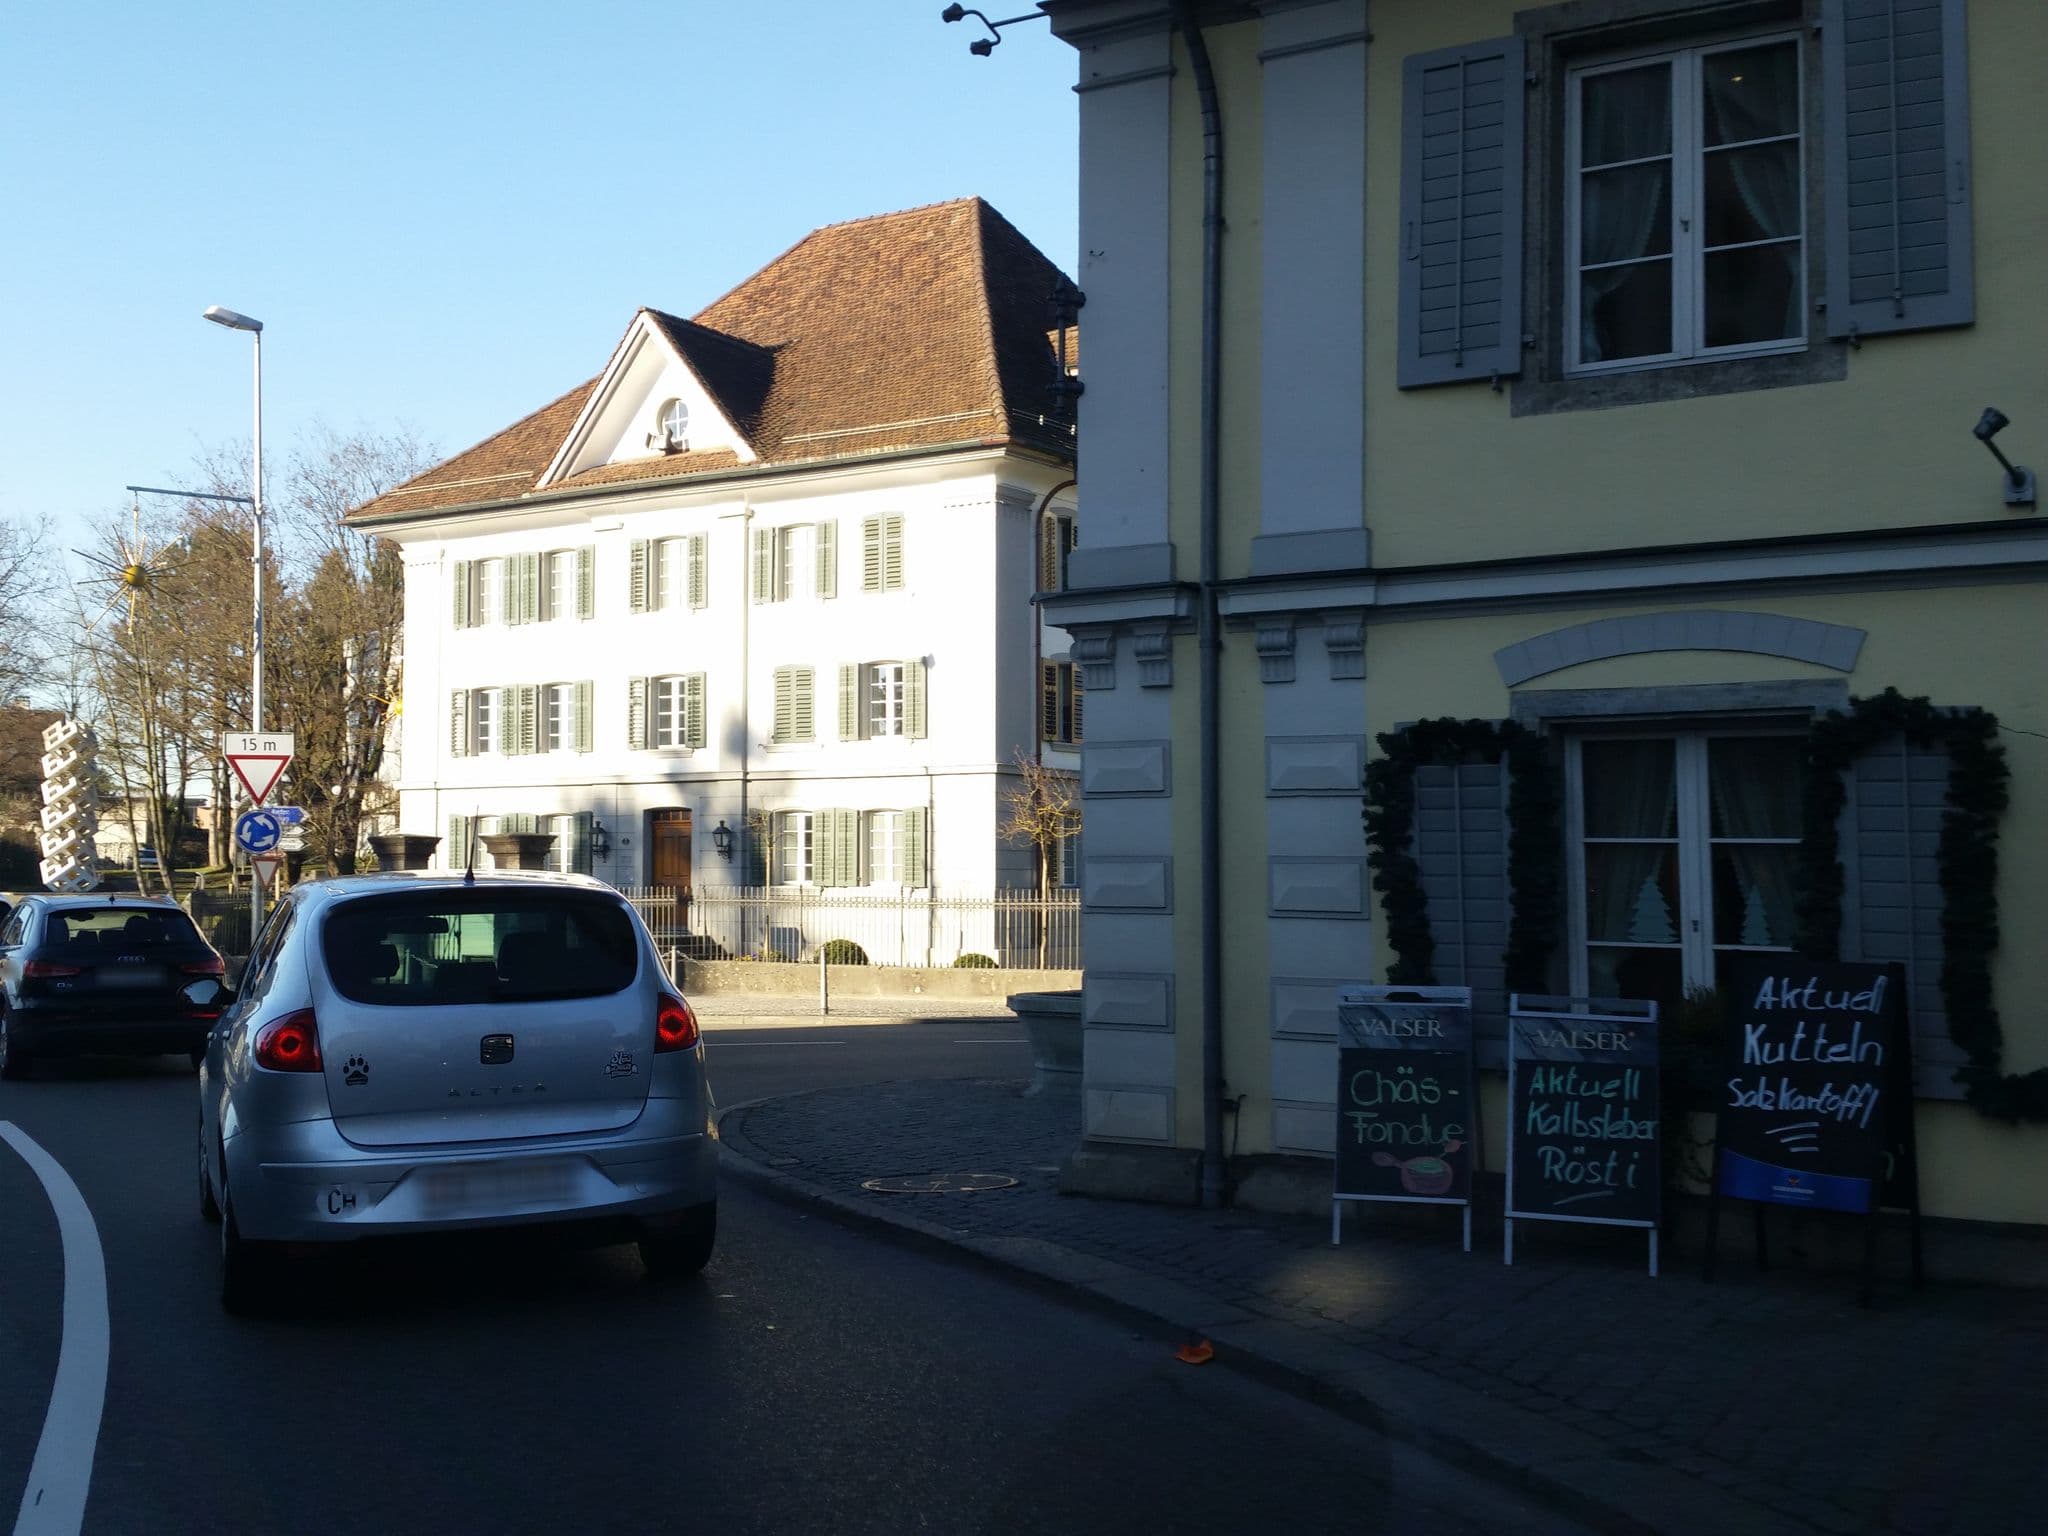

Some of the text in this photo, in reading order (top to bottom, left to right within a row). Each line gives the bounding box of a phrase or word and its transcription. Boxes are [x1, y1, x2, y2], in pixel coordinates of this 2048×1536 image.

[242, 738, 276, 751] 15 m
[1360, 1019, 1445, 1039] VALSER
[1537, 1030, 1632, 1051] VALSER
[1743, 1021, 1884, 1066] Kutteln
[1529, 1066, 1642, 1100] Aktuell
[1345, 1111, 1466, 1146] Fondue
[1538, 1145, 1641, 1190] Rösti
[327, 1188, 357, 1215] CH
